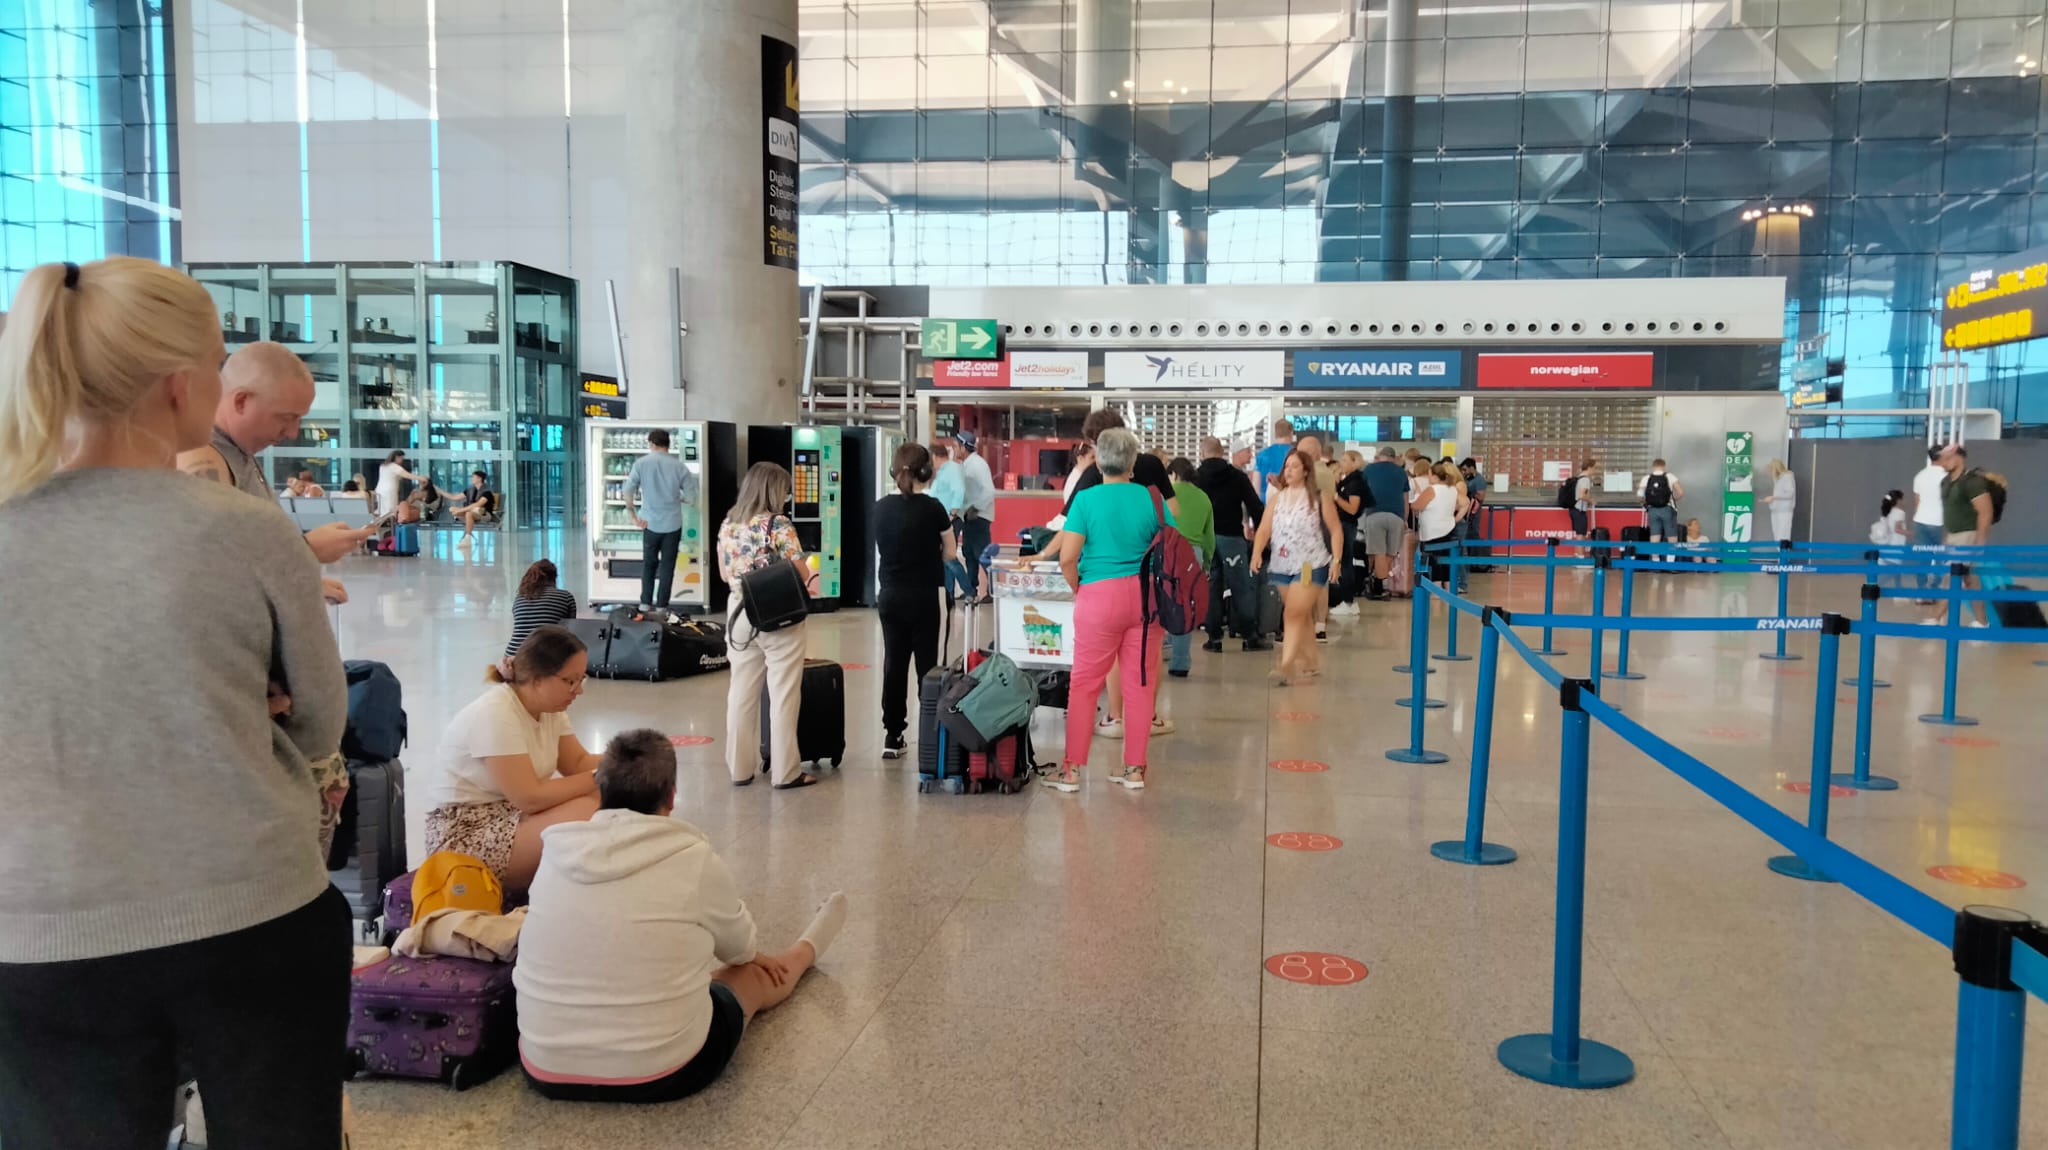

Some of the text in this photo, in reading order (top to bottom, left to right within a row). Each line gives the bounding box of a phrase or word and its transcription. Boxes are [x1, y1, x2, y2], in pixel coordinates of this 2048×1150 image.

[770, 242, 788, 257] Tax
[946, 360, 999, 373] Jet2.com
[1171, 361, 1245, 377] HÉLITY
[1321, 362, 1413, 376] RYANAIR
[1530, 364, 1599, 377] norwegian
[1726, 456, 1750, 464] DEA
[1757, 618, 1823, 630] RYANAIR
